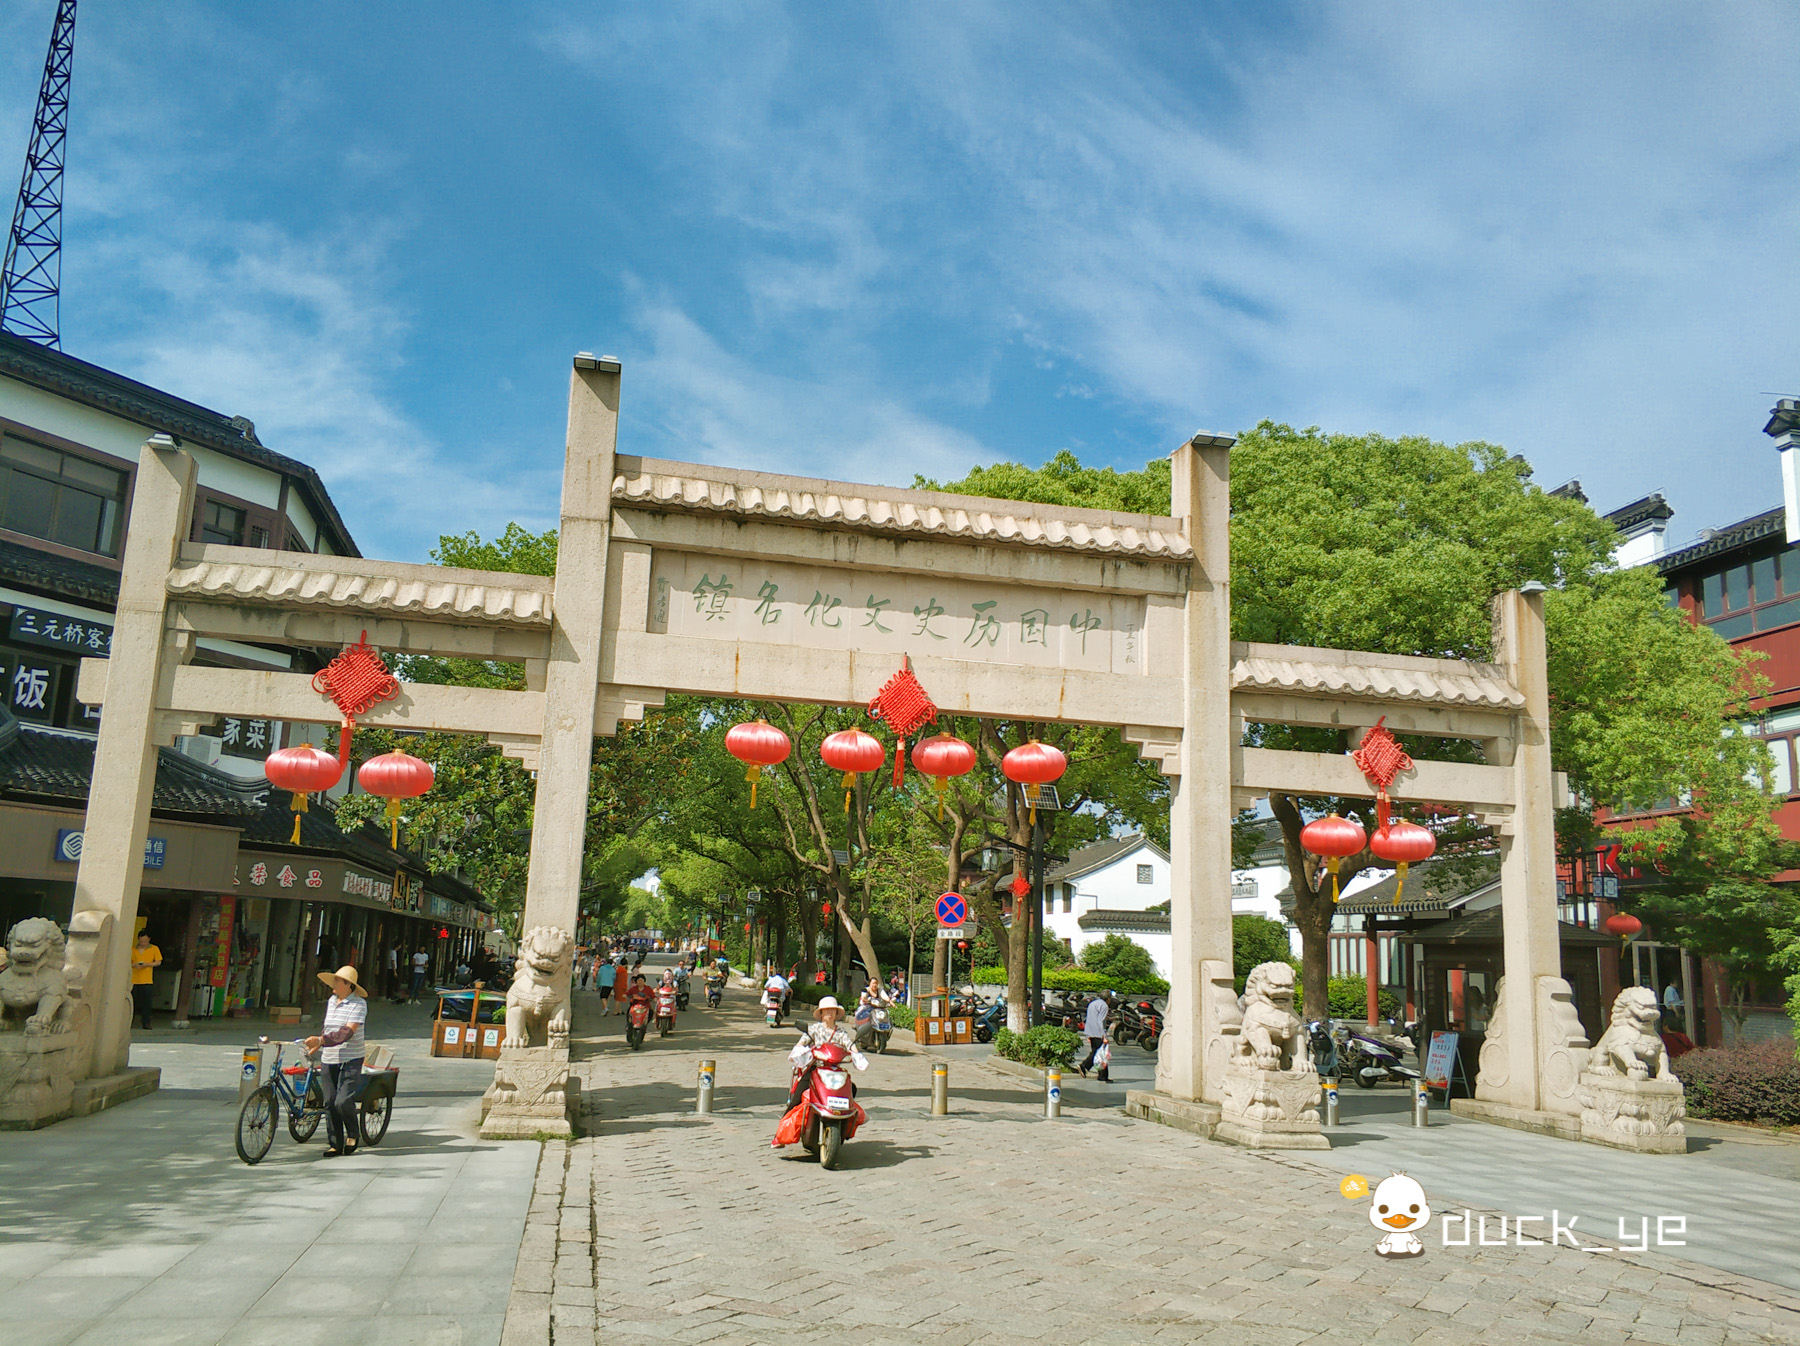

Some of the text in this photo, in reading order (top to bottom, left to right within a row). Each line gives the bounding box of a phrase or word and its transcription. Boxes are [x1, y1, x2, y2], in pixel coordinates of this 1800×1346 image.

[692, 573, 1102, 656] 中国历史文化名镇
[20, 615, 113, 652] 三元桥客
[233, 862, 323, 888] 荣食品
